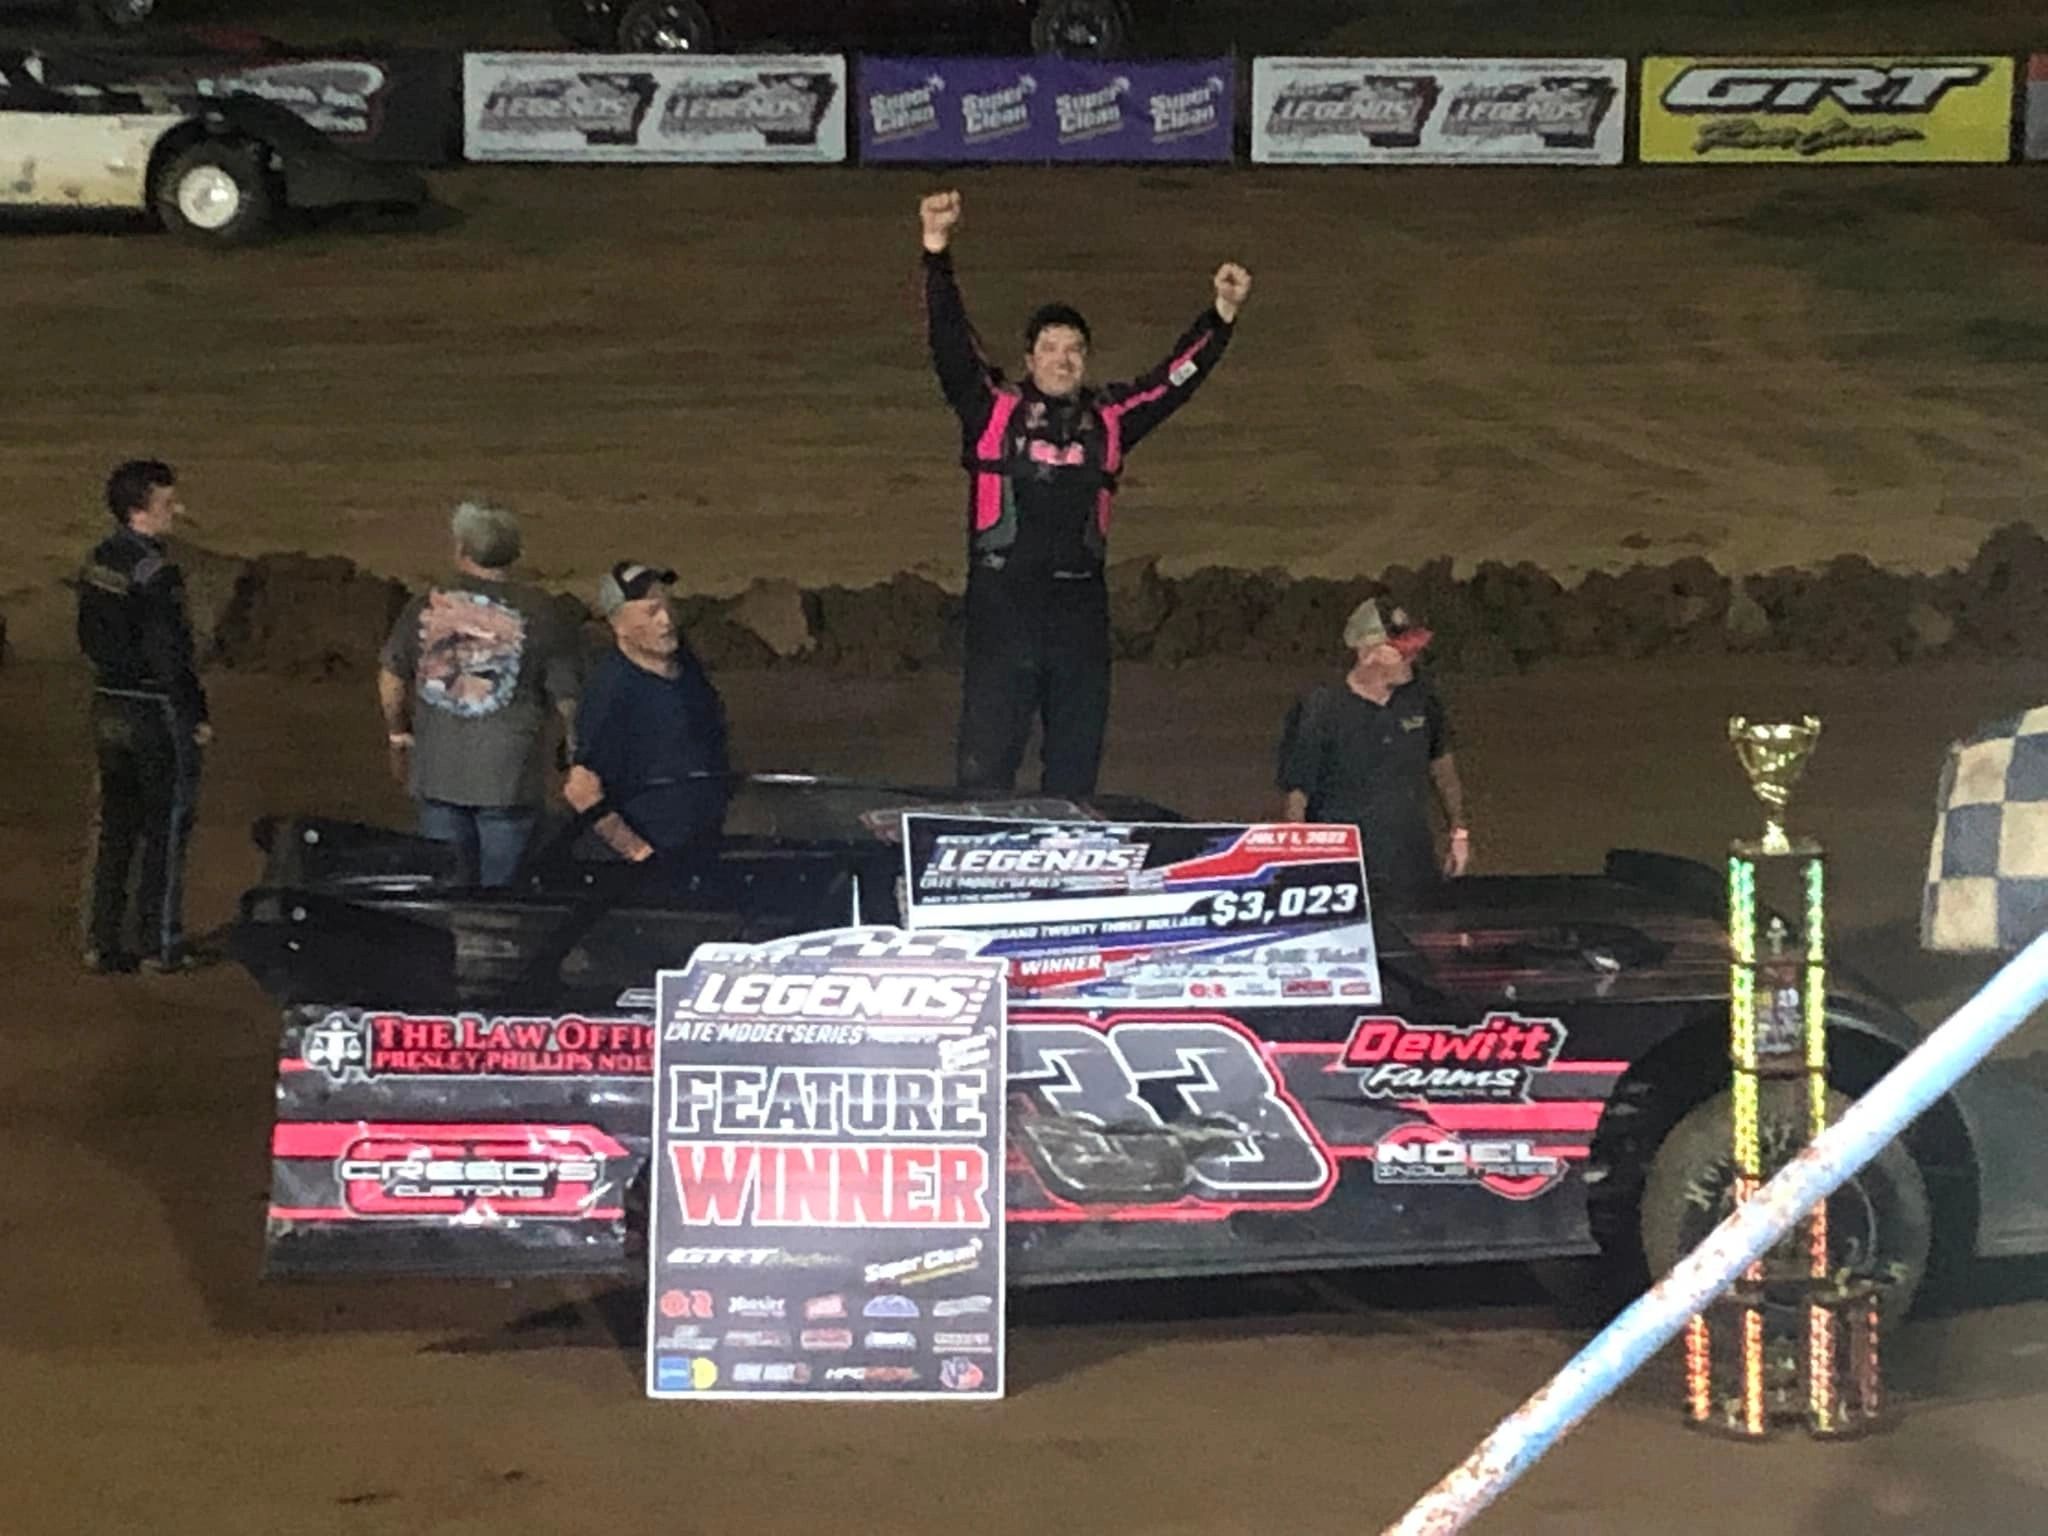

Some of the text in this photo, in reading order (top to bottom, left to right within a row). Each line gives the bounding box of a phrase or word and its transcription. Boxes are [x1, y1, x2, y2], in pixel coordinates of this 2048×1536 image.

[1662, 65, 1991, 112] GRT
[938, 848, 1140, 872] LEGENDS
[1211, 883, 1359, 926] $3,023
[1020, 953, 1103, 976] WINNER
[692, 972, 978, 1019] LEGENDS
[375, 1017, 450, 1048] THE
[460, 1018, 547, 1050] LAW
[664, 1022, 713, 1043] LATE
[717, 1022, 788, 1043] MODEL
[790, 1023, 865, 1044] SERIES
[1347, 1018, 1551, 1062] Dewitt
[375, 1050, 479, 1071] PRESLEY
[484, 1050, 593, 1071] PHILLIPS
[1366, 1063, 1521, 1088] Farms
[667, 1064, 988, 1137] FEATURE
[1376, 1141, 1558, 1164] NOEL
[340, 1158, 600, 1182] CREED'S
[667, 1140, 991, 1229] WINNER
